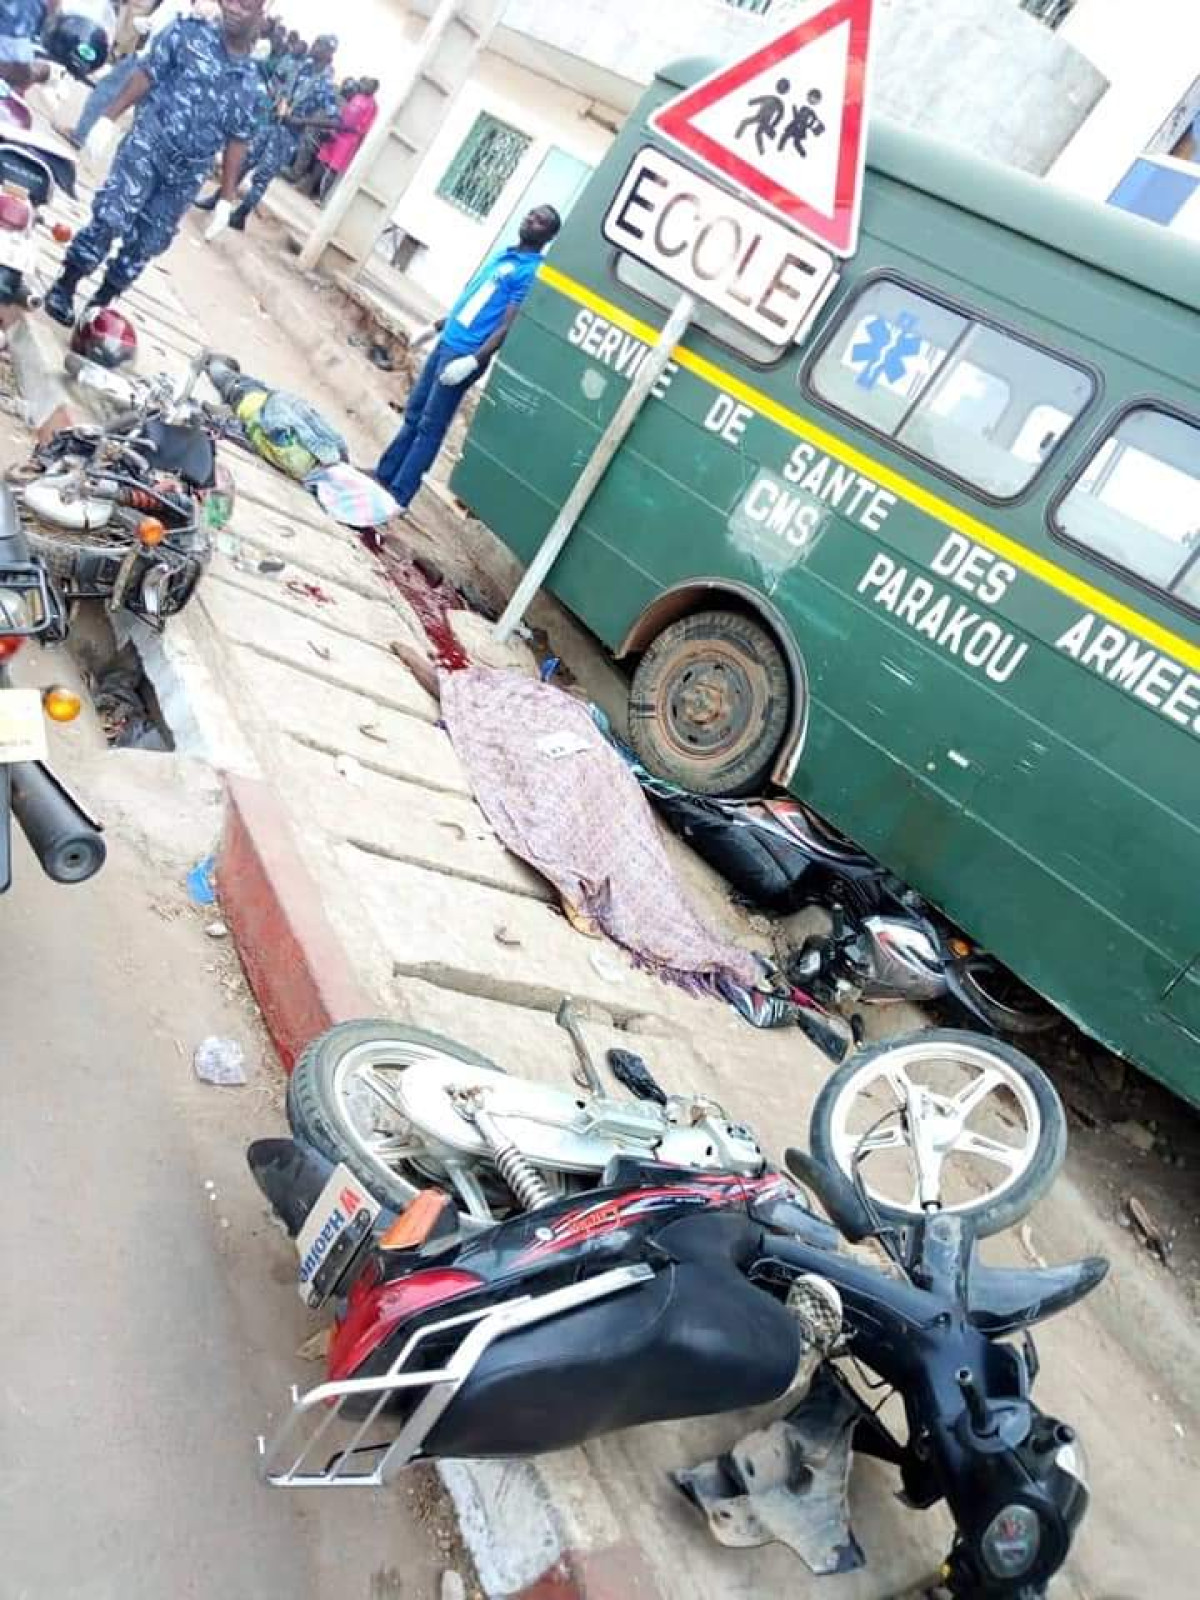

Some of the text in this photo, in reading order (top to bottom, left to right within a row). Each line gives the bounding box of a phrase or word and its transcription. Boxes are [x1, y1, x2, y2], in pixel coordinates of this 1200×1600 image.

[615, 167, 815, 328] ECOLE
[567, 309, 1200, 735] SERVIE DE SANTE DES ARMEE
[744, 479, 820, 547] CMS
[857, 553, 1029, 683] PARAKOU
